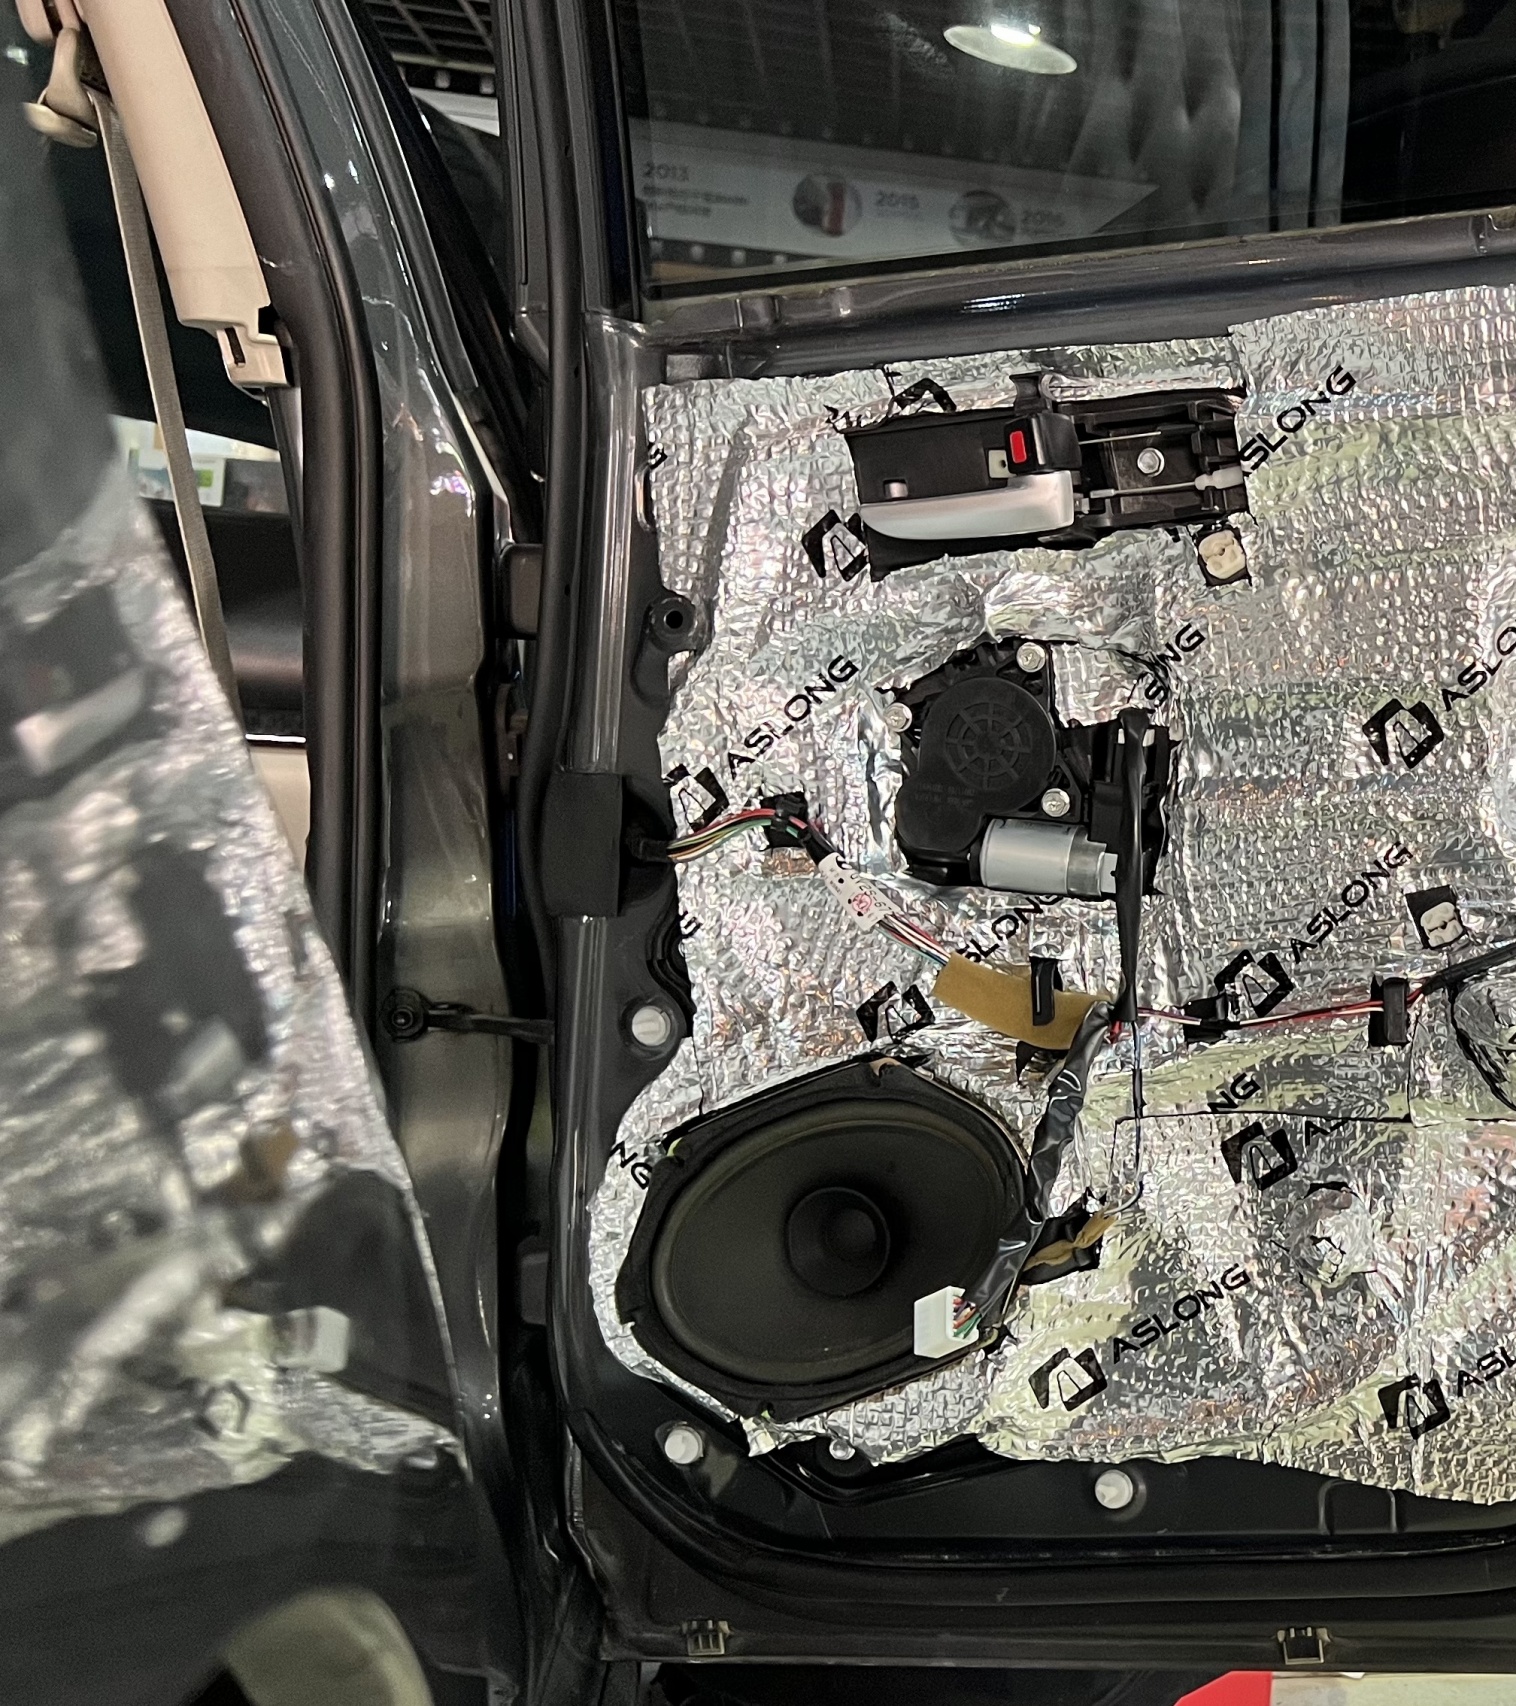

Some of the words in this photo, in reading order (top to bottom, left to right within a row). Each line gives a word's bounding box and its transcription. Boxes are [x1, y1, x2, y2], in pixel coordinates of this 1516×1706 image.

[1240, 365, 1356, 477] SLONG
[725, 654, 859, 778] ASLONG
[1290, 841, 1412, 962] ASLONG
[1112, 1263, 1251, 1363] ASLONG
